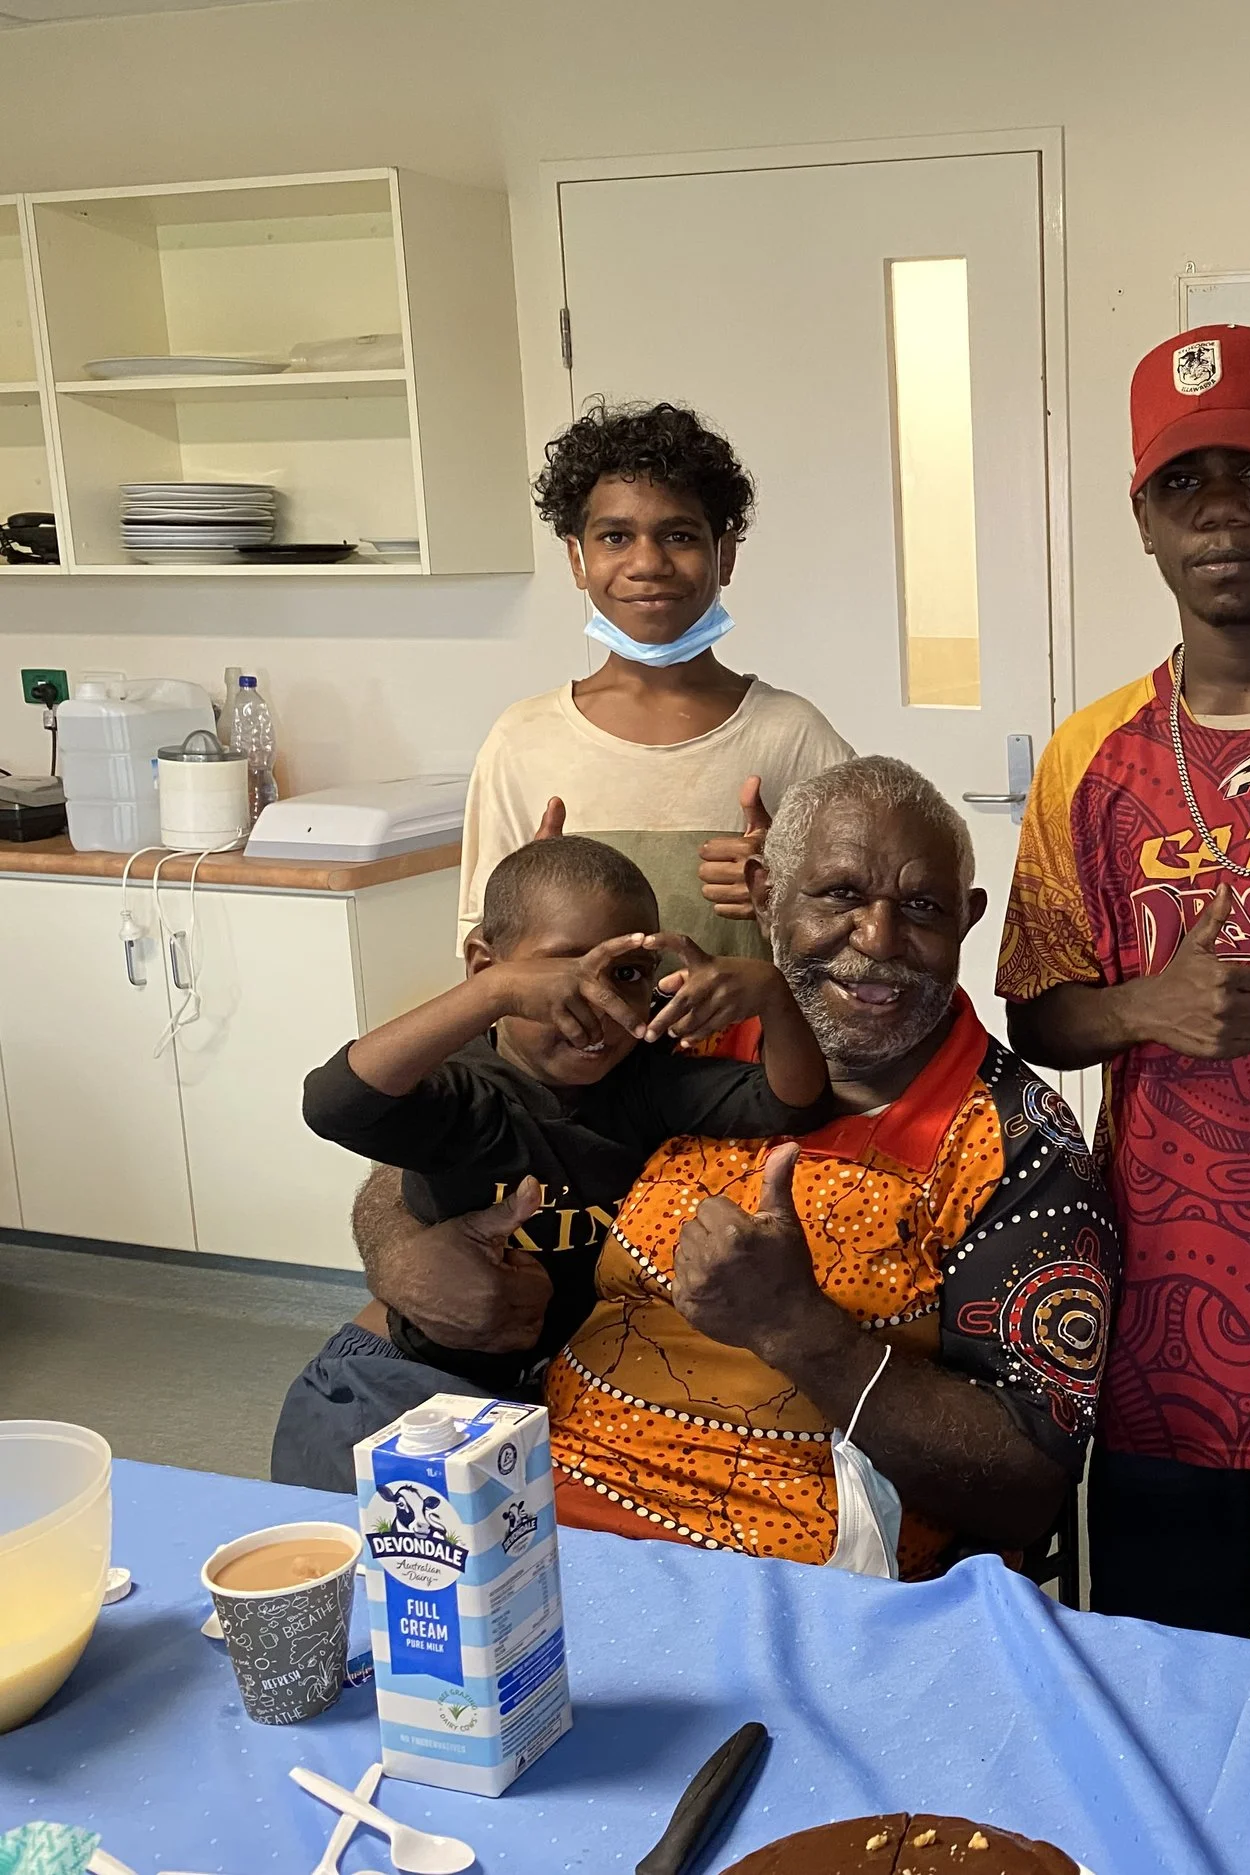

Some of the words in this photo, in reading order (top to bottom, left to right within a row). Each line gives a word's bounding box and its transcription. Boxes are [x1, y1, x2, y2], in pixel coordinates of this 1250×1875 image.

[503, 1518, 538, 1549] DEVONDALE
[372, 1536, 463, 1567] DEVONDALE
[396, 1560, 442, 1575] Australian
[408, 1572, 432, 1588] Dairy
[281, 1597, 337, 1639] BREATHE
[406, 1598, 440, 1620] FULL
[400, 1618, 448, 1642] CREAM
[406, 1638, 425, 1650] PURE
[426, 1641, 445, 1653] MILK
[261, 1669, 302, 1691] REFRESH
